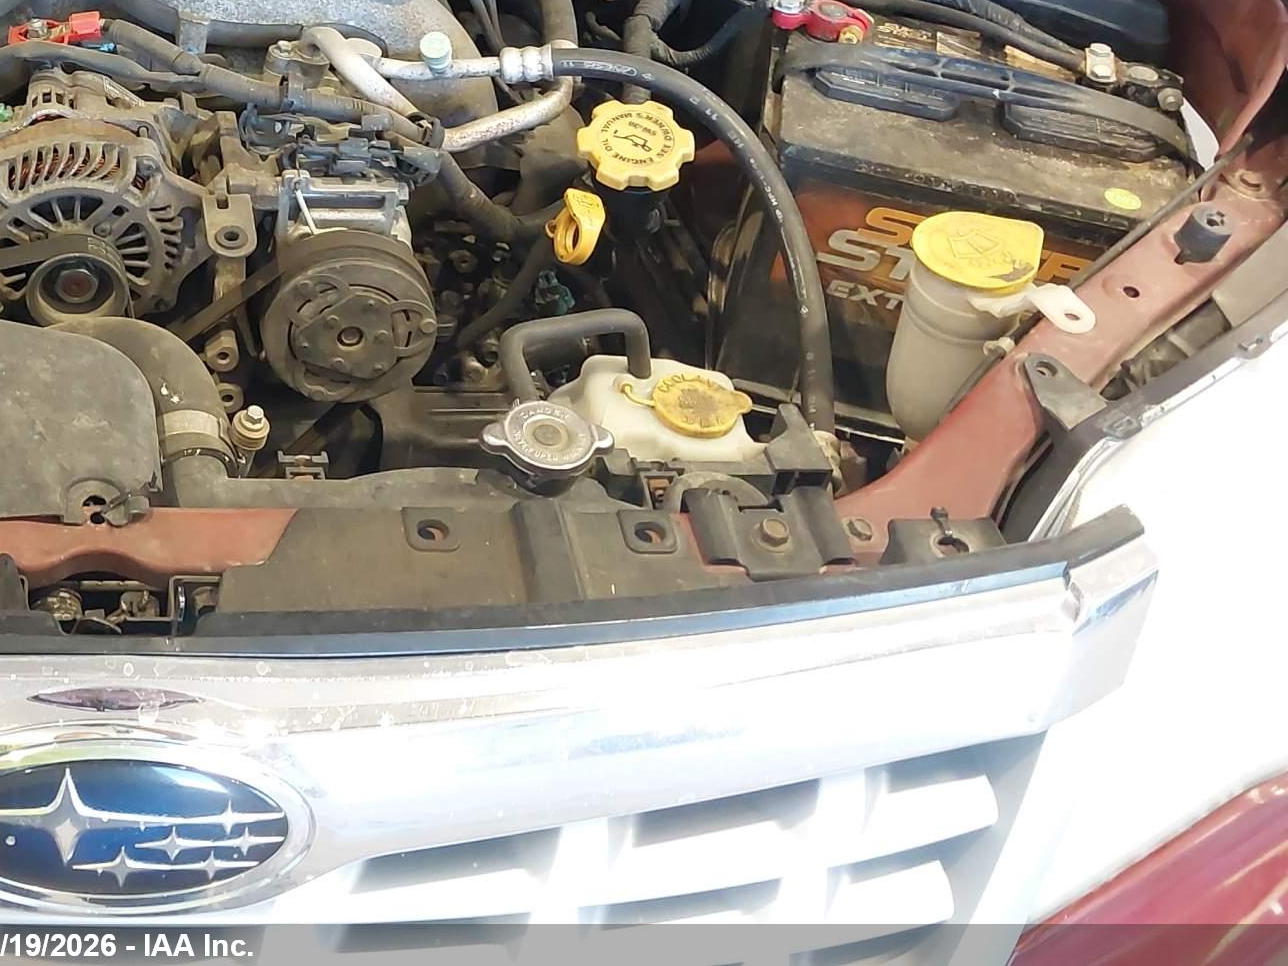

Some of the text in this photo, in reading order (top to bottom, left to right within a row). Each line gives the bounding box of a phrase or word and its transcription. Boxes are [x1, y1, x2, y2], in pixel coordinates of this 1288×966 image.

[601, 113, 633, 132] MANUAL
[601, 138, 654, 165] ENGINE OIL
